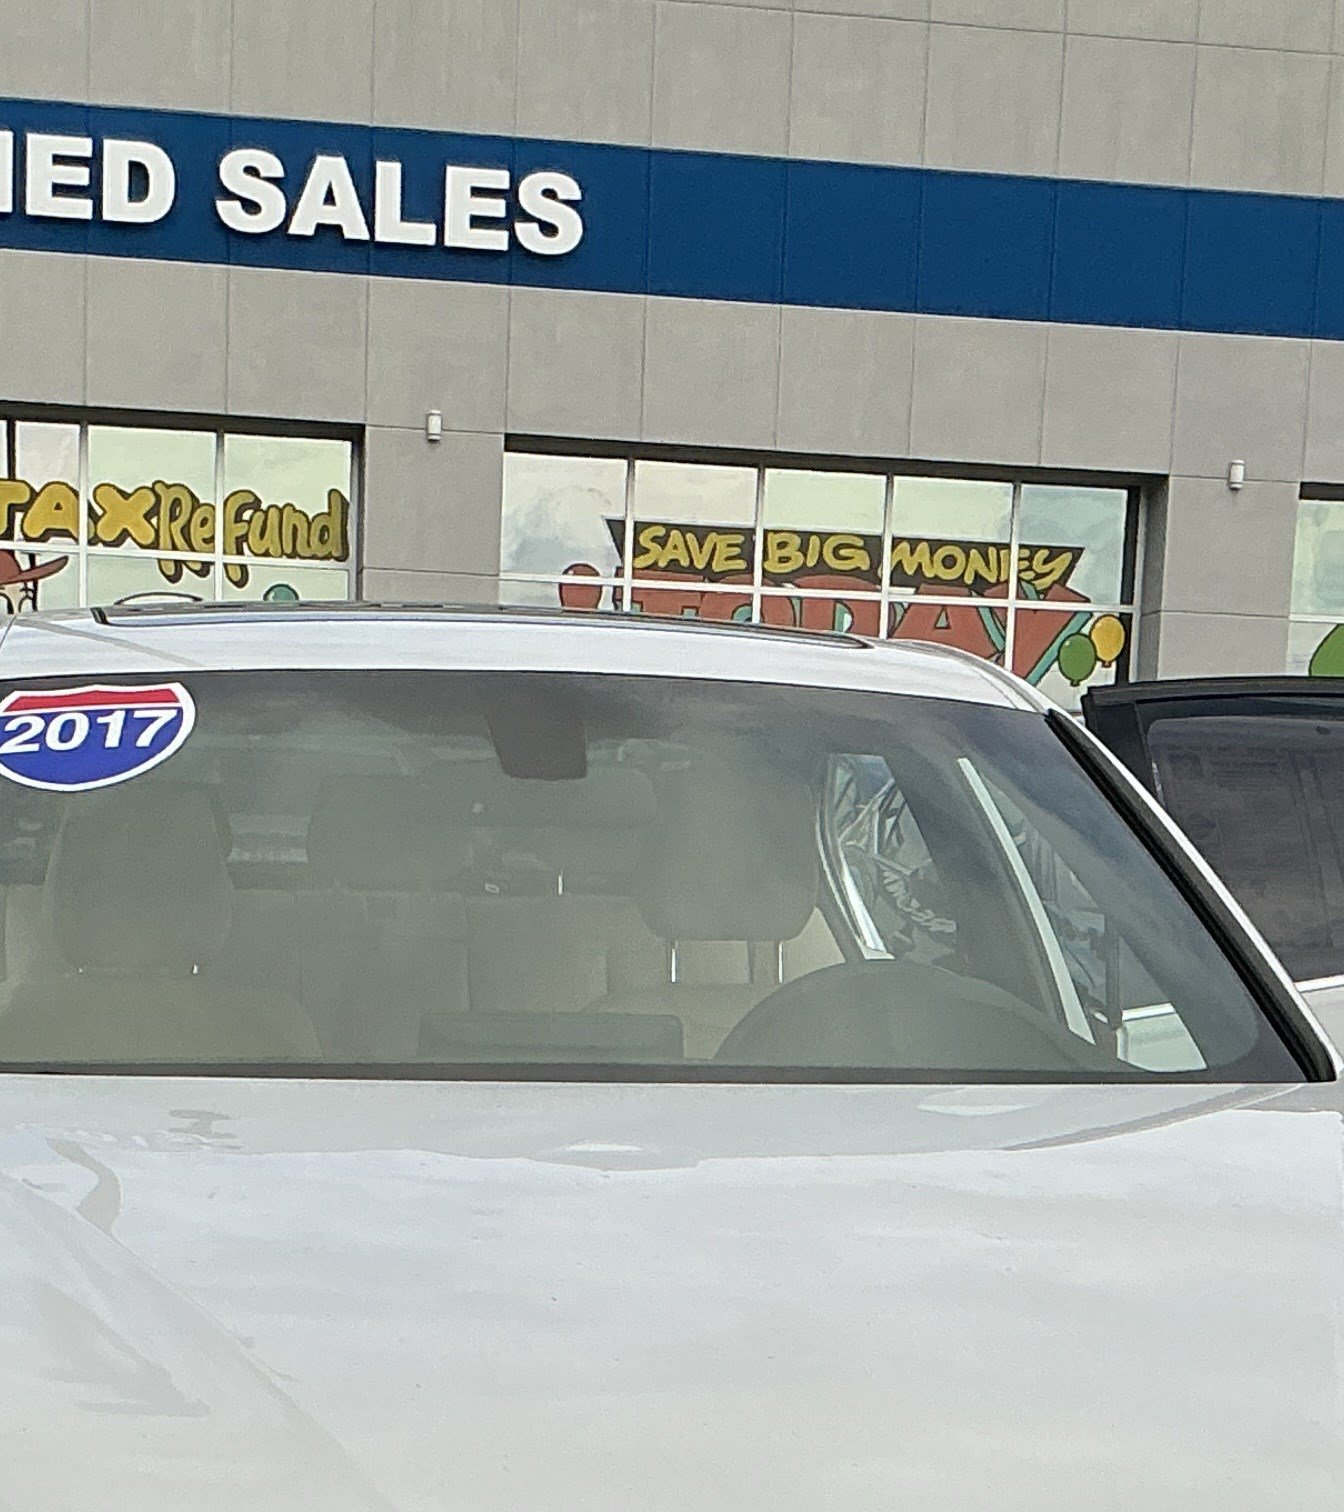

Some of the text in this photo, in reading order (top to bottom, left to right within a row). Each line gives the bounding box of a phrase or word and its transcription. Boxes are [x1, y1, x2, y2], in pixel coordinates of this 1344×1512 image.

[215, 148, 585, 256] SALES
[632, 525, 1073, 591] SAVE BIG MONEY
